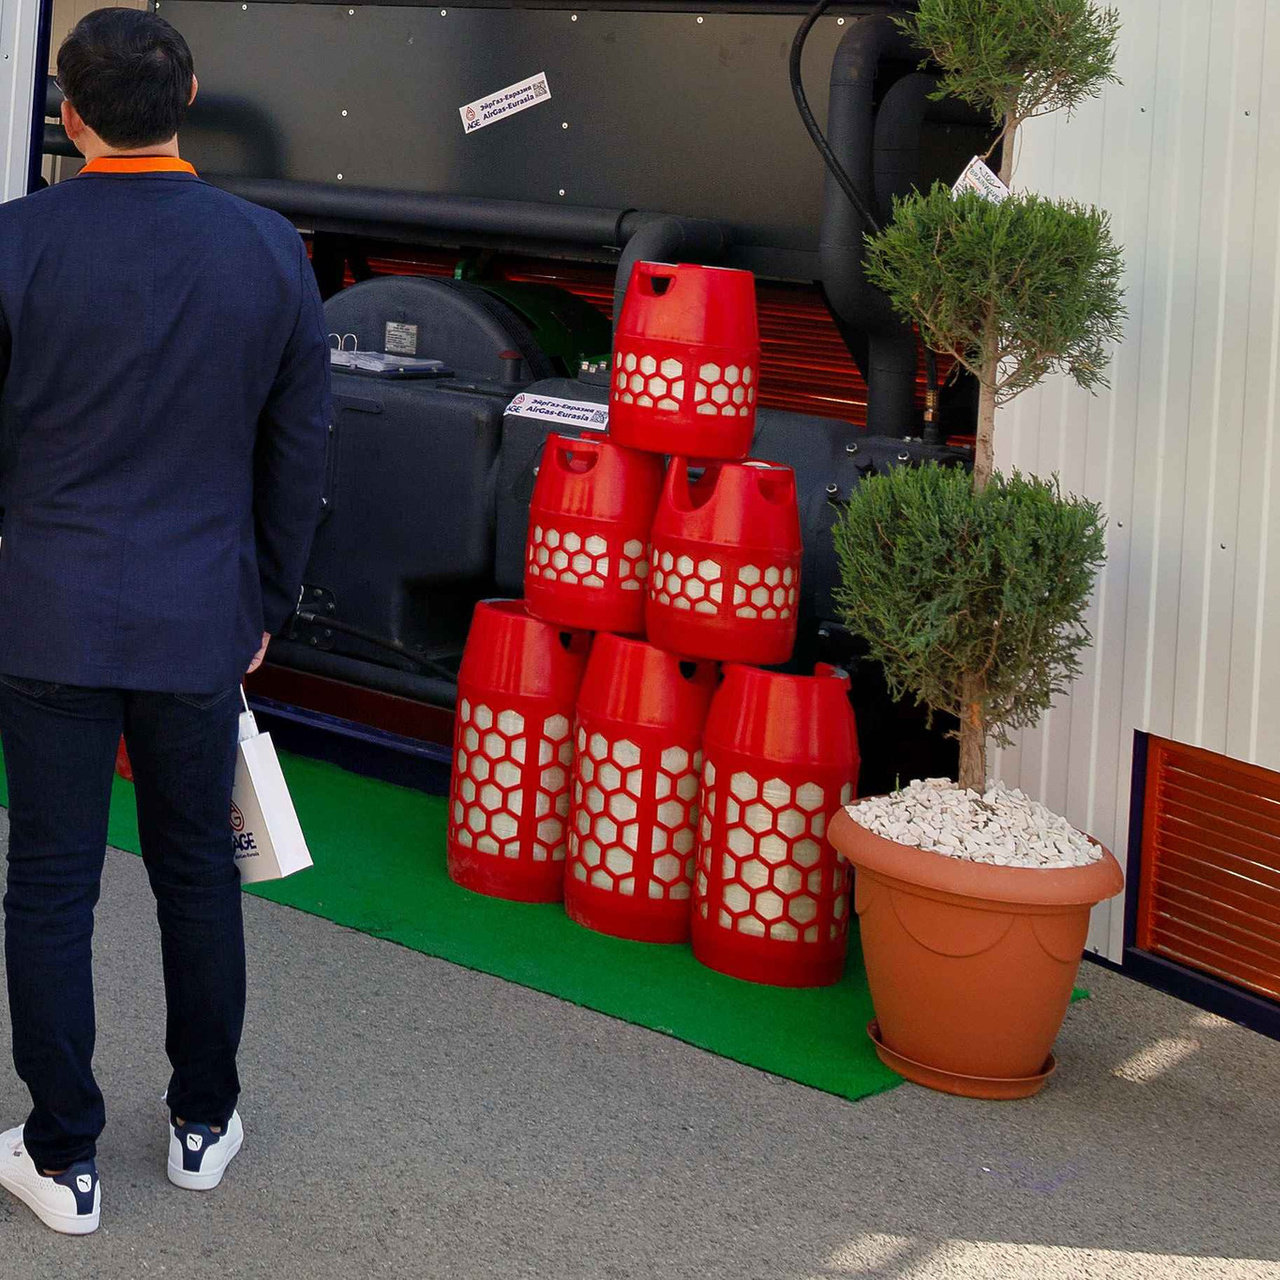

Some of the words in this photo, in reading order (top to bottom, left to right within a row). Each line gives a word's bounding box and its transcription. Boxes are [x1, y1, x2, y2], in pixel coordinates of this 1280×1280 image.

[480, 85, 532, 111] ЭйрГаз-Евразия
[483, 93, 534, 120] AirGas-Eurasia
[467, 119, 481, 130] AGE
[526, 406, 589, 421] AirGas-Eurasia
[531, 399, 595, 414] ЭйрГаз-Евразия
[233, 832, 257, 851] AGE
